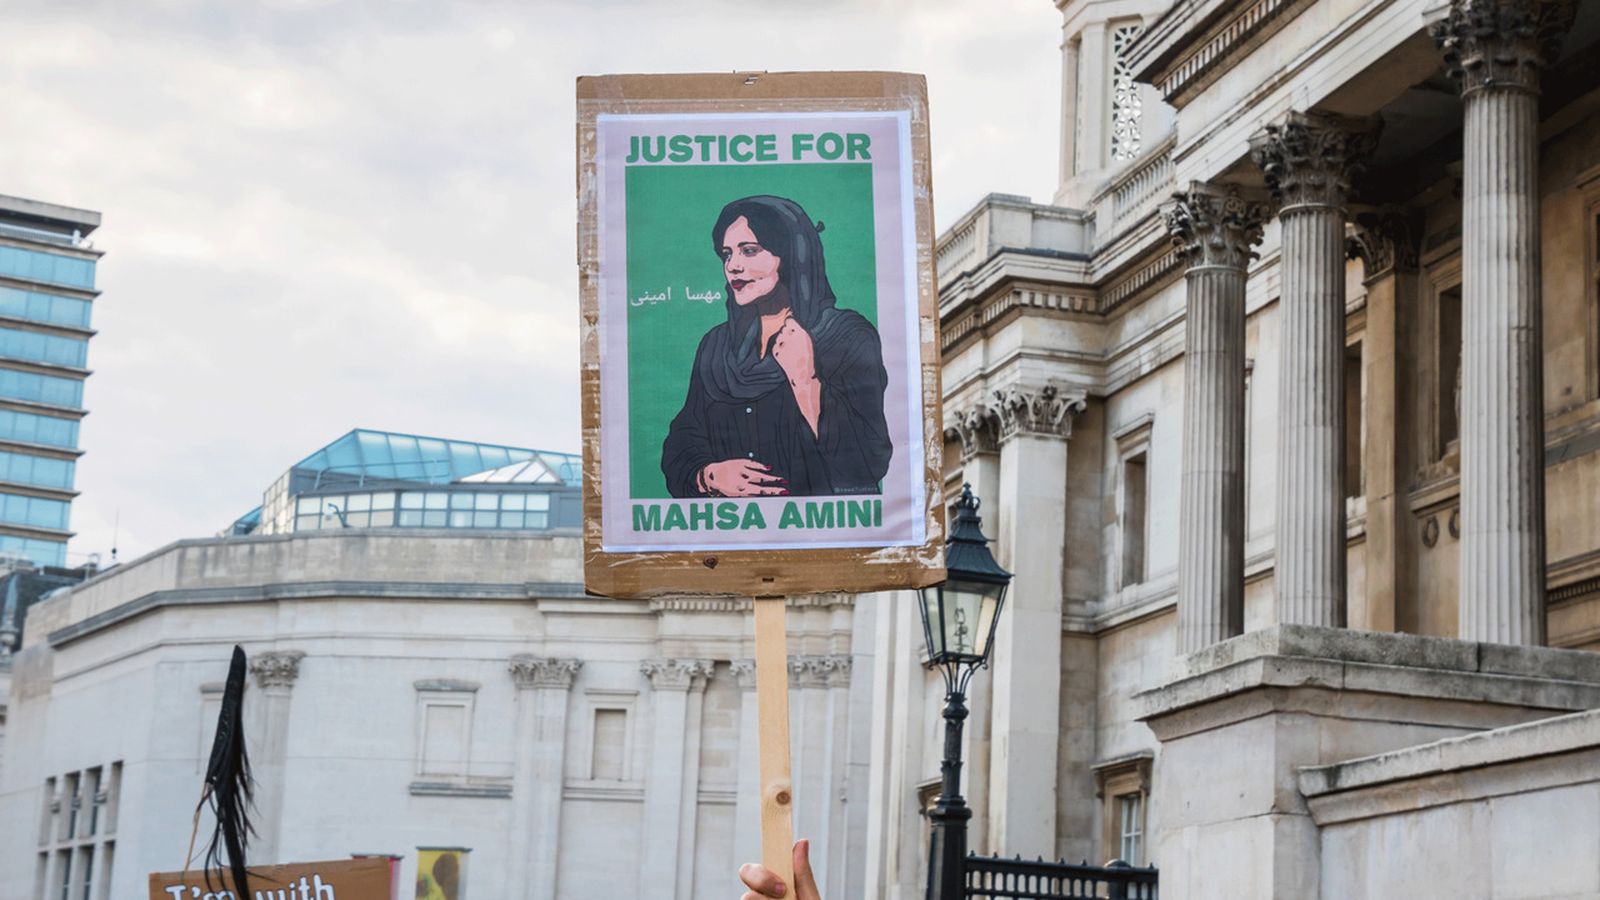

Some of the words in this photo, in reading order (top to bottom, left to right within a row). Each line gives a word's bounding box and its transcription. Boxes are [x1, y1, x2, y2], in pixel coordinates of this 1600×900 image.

[626, 134, 778, 163] JUSTICE
[791, 132, 871, 161] FOR
[685, 286, 722, 304] مهسا
[632, 502, 767, 532] MAHSA
[778, 500, 882, 529] AMINI
